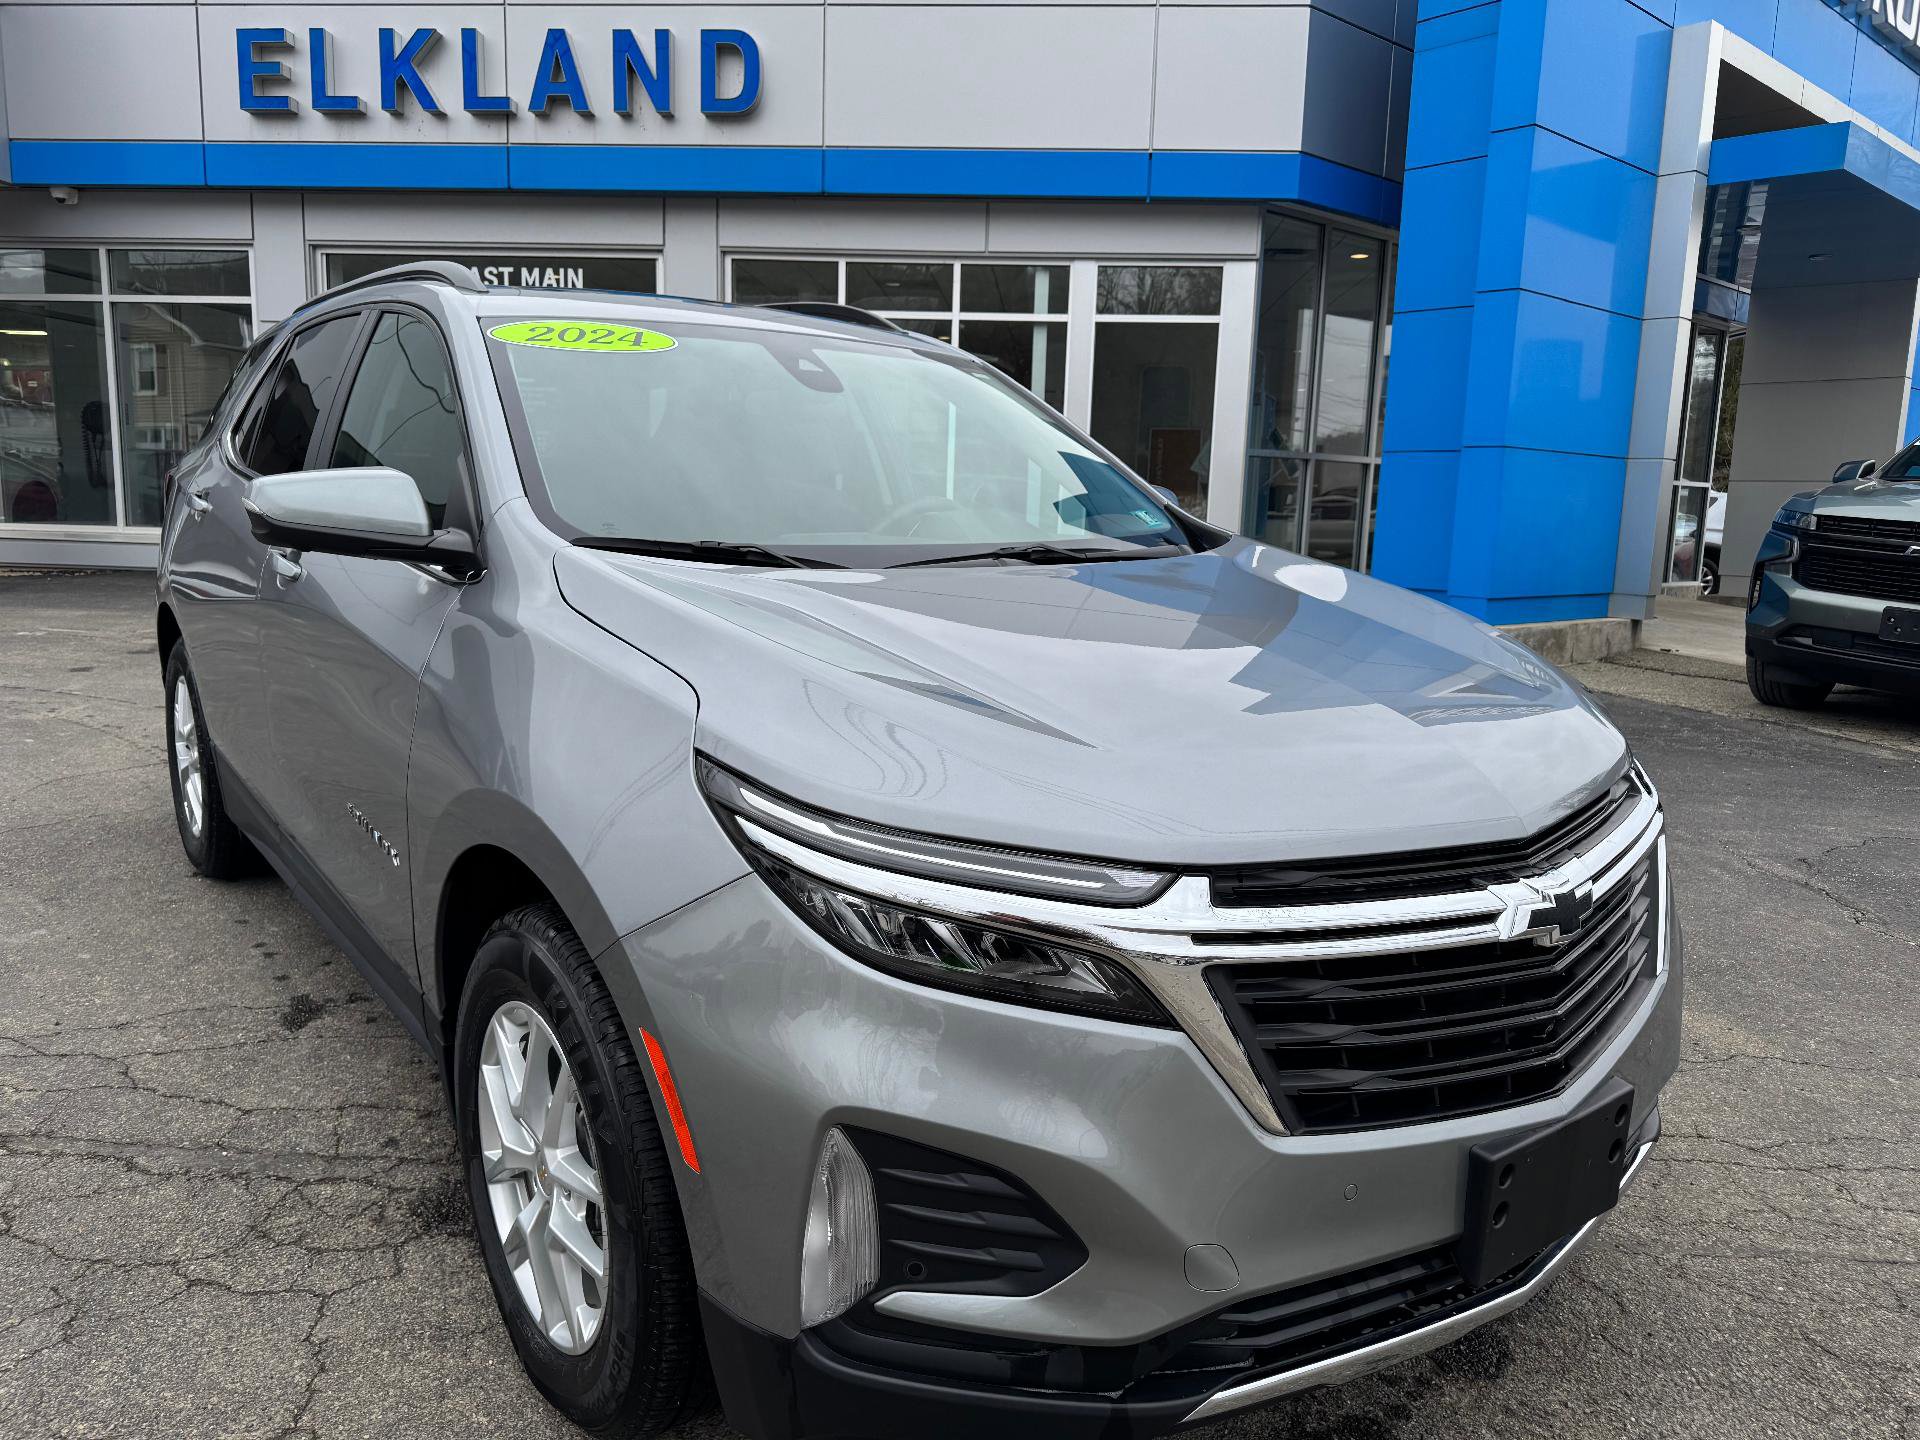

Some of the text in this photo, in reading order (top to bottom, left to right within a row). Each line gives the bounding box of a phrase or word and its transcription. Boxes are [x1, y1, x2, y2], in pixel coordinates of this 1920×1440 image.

[236, 27, 763, 115] ELKLAND
[470, 266, 584, 289] AST MAIN
[525, 326, 649, 347] 2024
